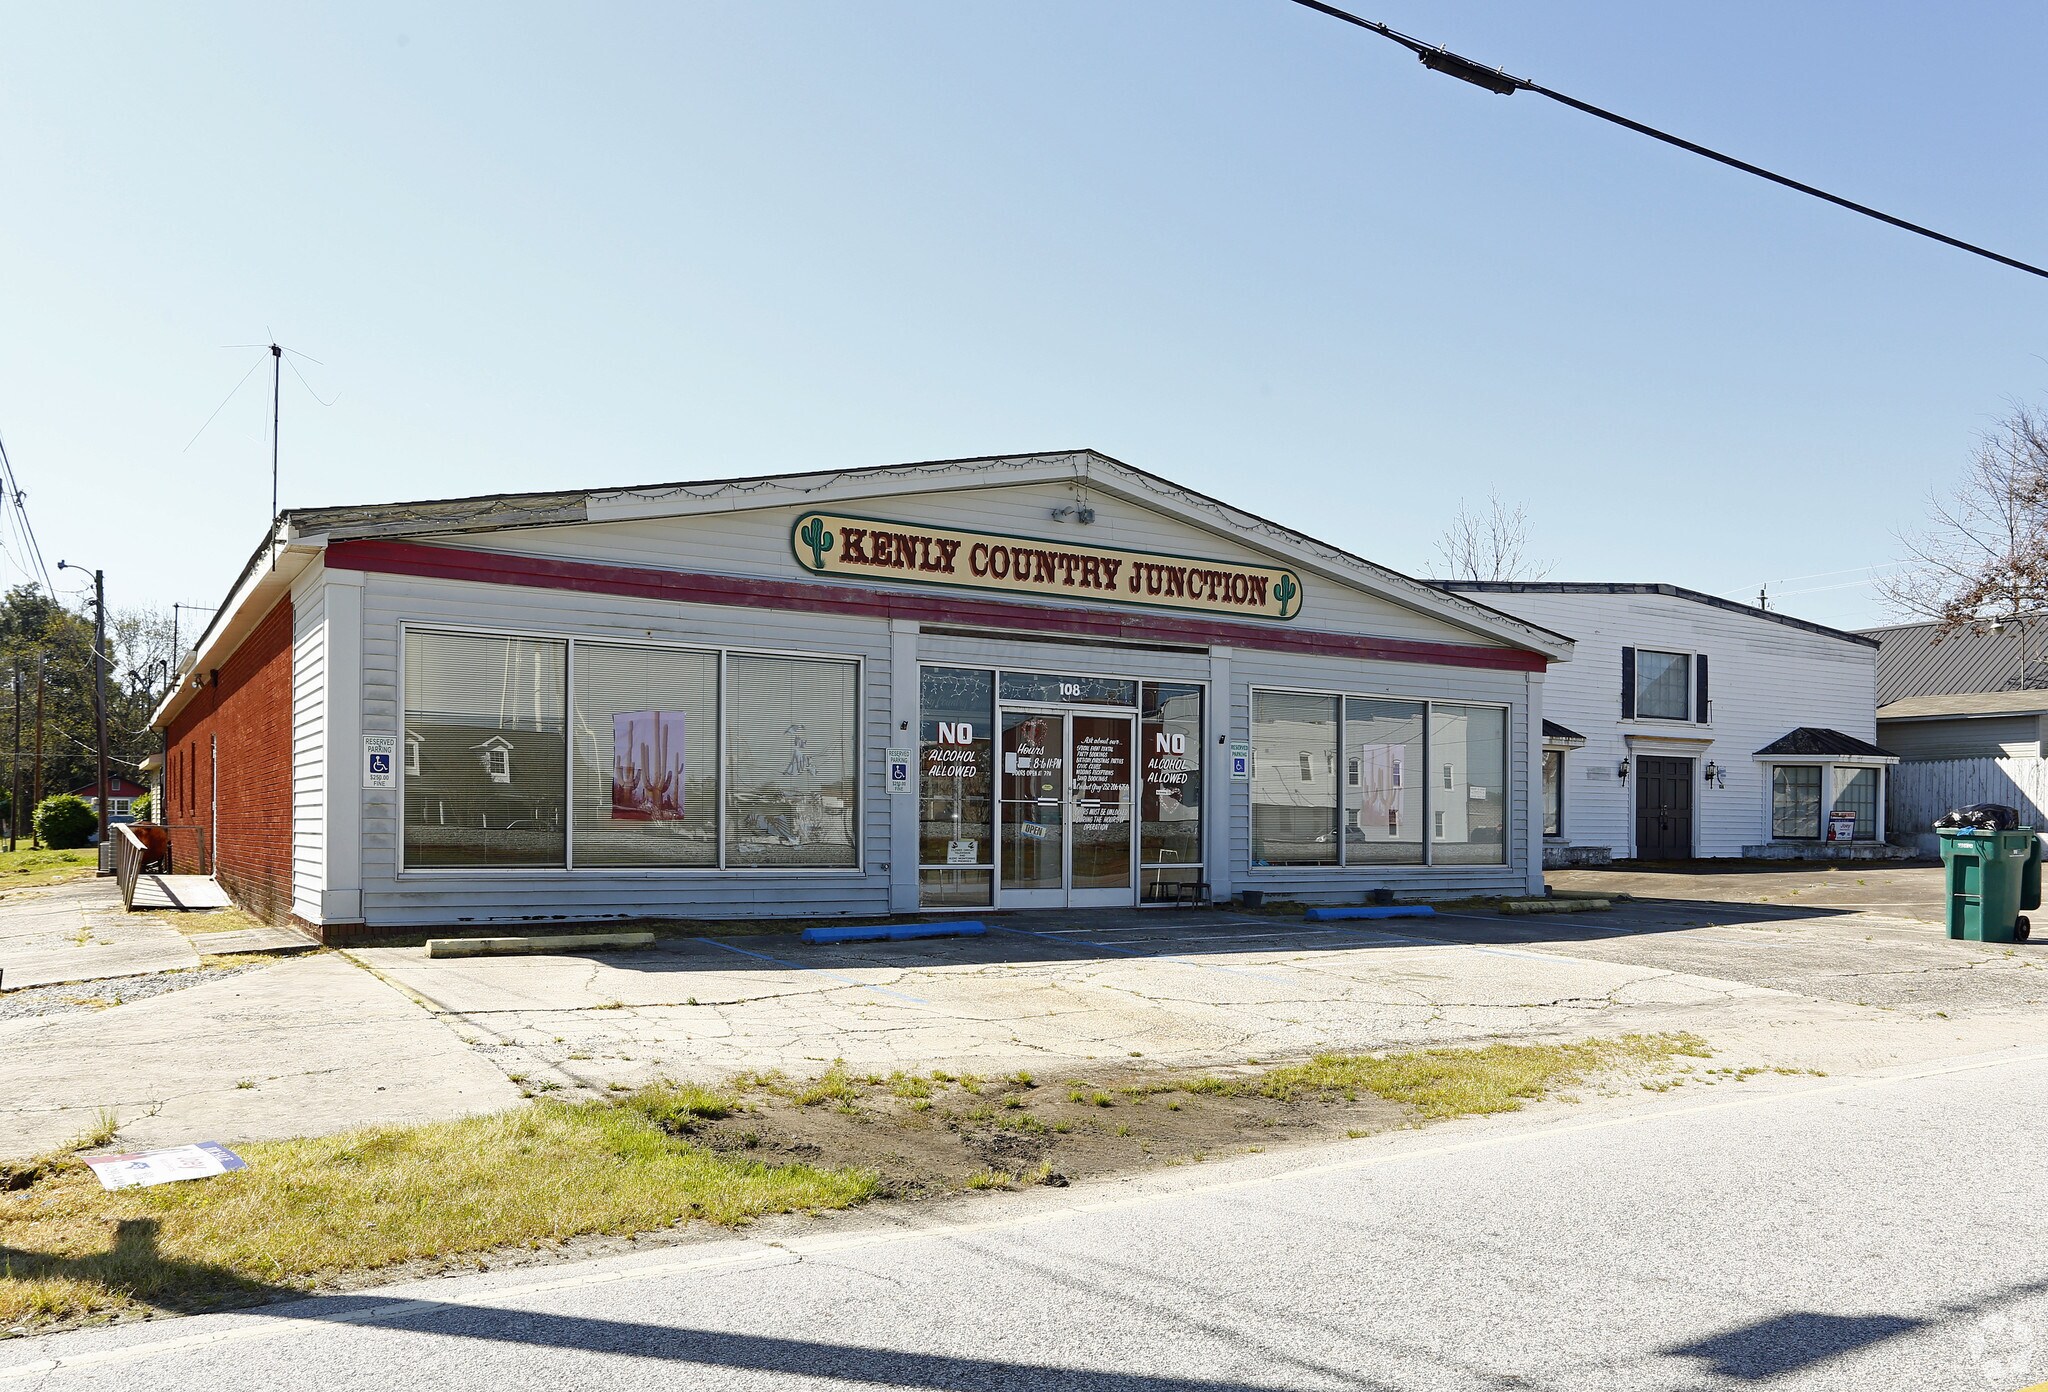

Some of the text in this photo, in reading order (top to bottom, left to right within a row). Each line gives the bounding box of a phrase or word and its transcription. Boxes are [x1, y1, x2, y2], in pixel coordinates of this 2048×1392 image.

[839, 527, 1269, 606] KENLY COUNTRY JUNCTION
[1059, 682, 1081, 697] 108
[938, 721, 973, 746] NO
[1017, 743, 1045, 755] Hours
[1156, 732, 1186, 756] NO
[928, 749, 976, 762] ALCOHOL
[1148, 758, 1187, 771] ALCOHOL
[928, 765, 977, 778] ALLOWED
[1012, 769, 1026, 777] OORS
[1147, 772, 1188, 784] ALLOWED
[1025, 824, 1042, 836] OPEN
